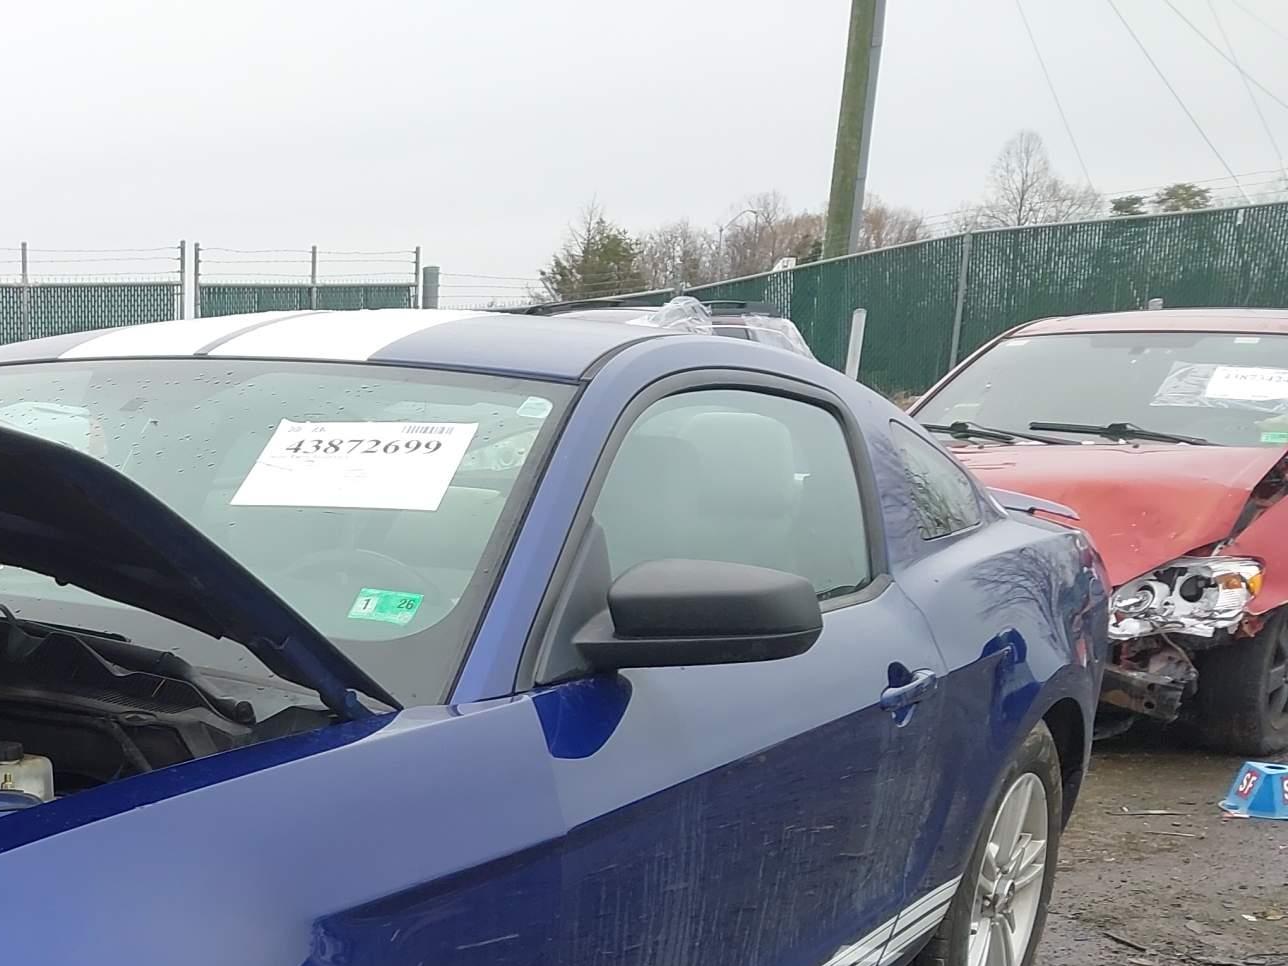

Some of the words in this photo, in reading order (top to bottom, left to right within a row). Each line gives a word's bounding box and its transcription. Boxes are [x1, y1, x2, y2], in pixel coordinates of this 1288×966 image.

[285, 439, 443, 454] 43872699
[362, 598, 371, 610] 1
[397, 598, 416, 610] 26
[1238, 773, 1258, 795] SF
